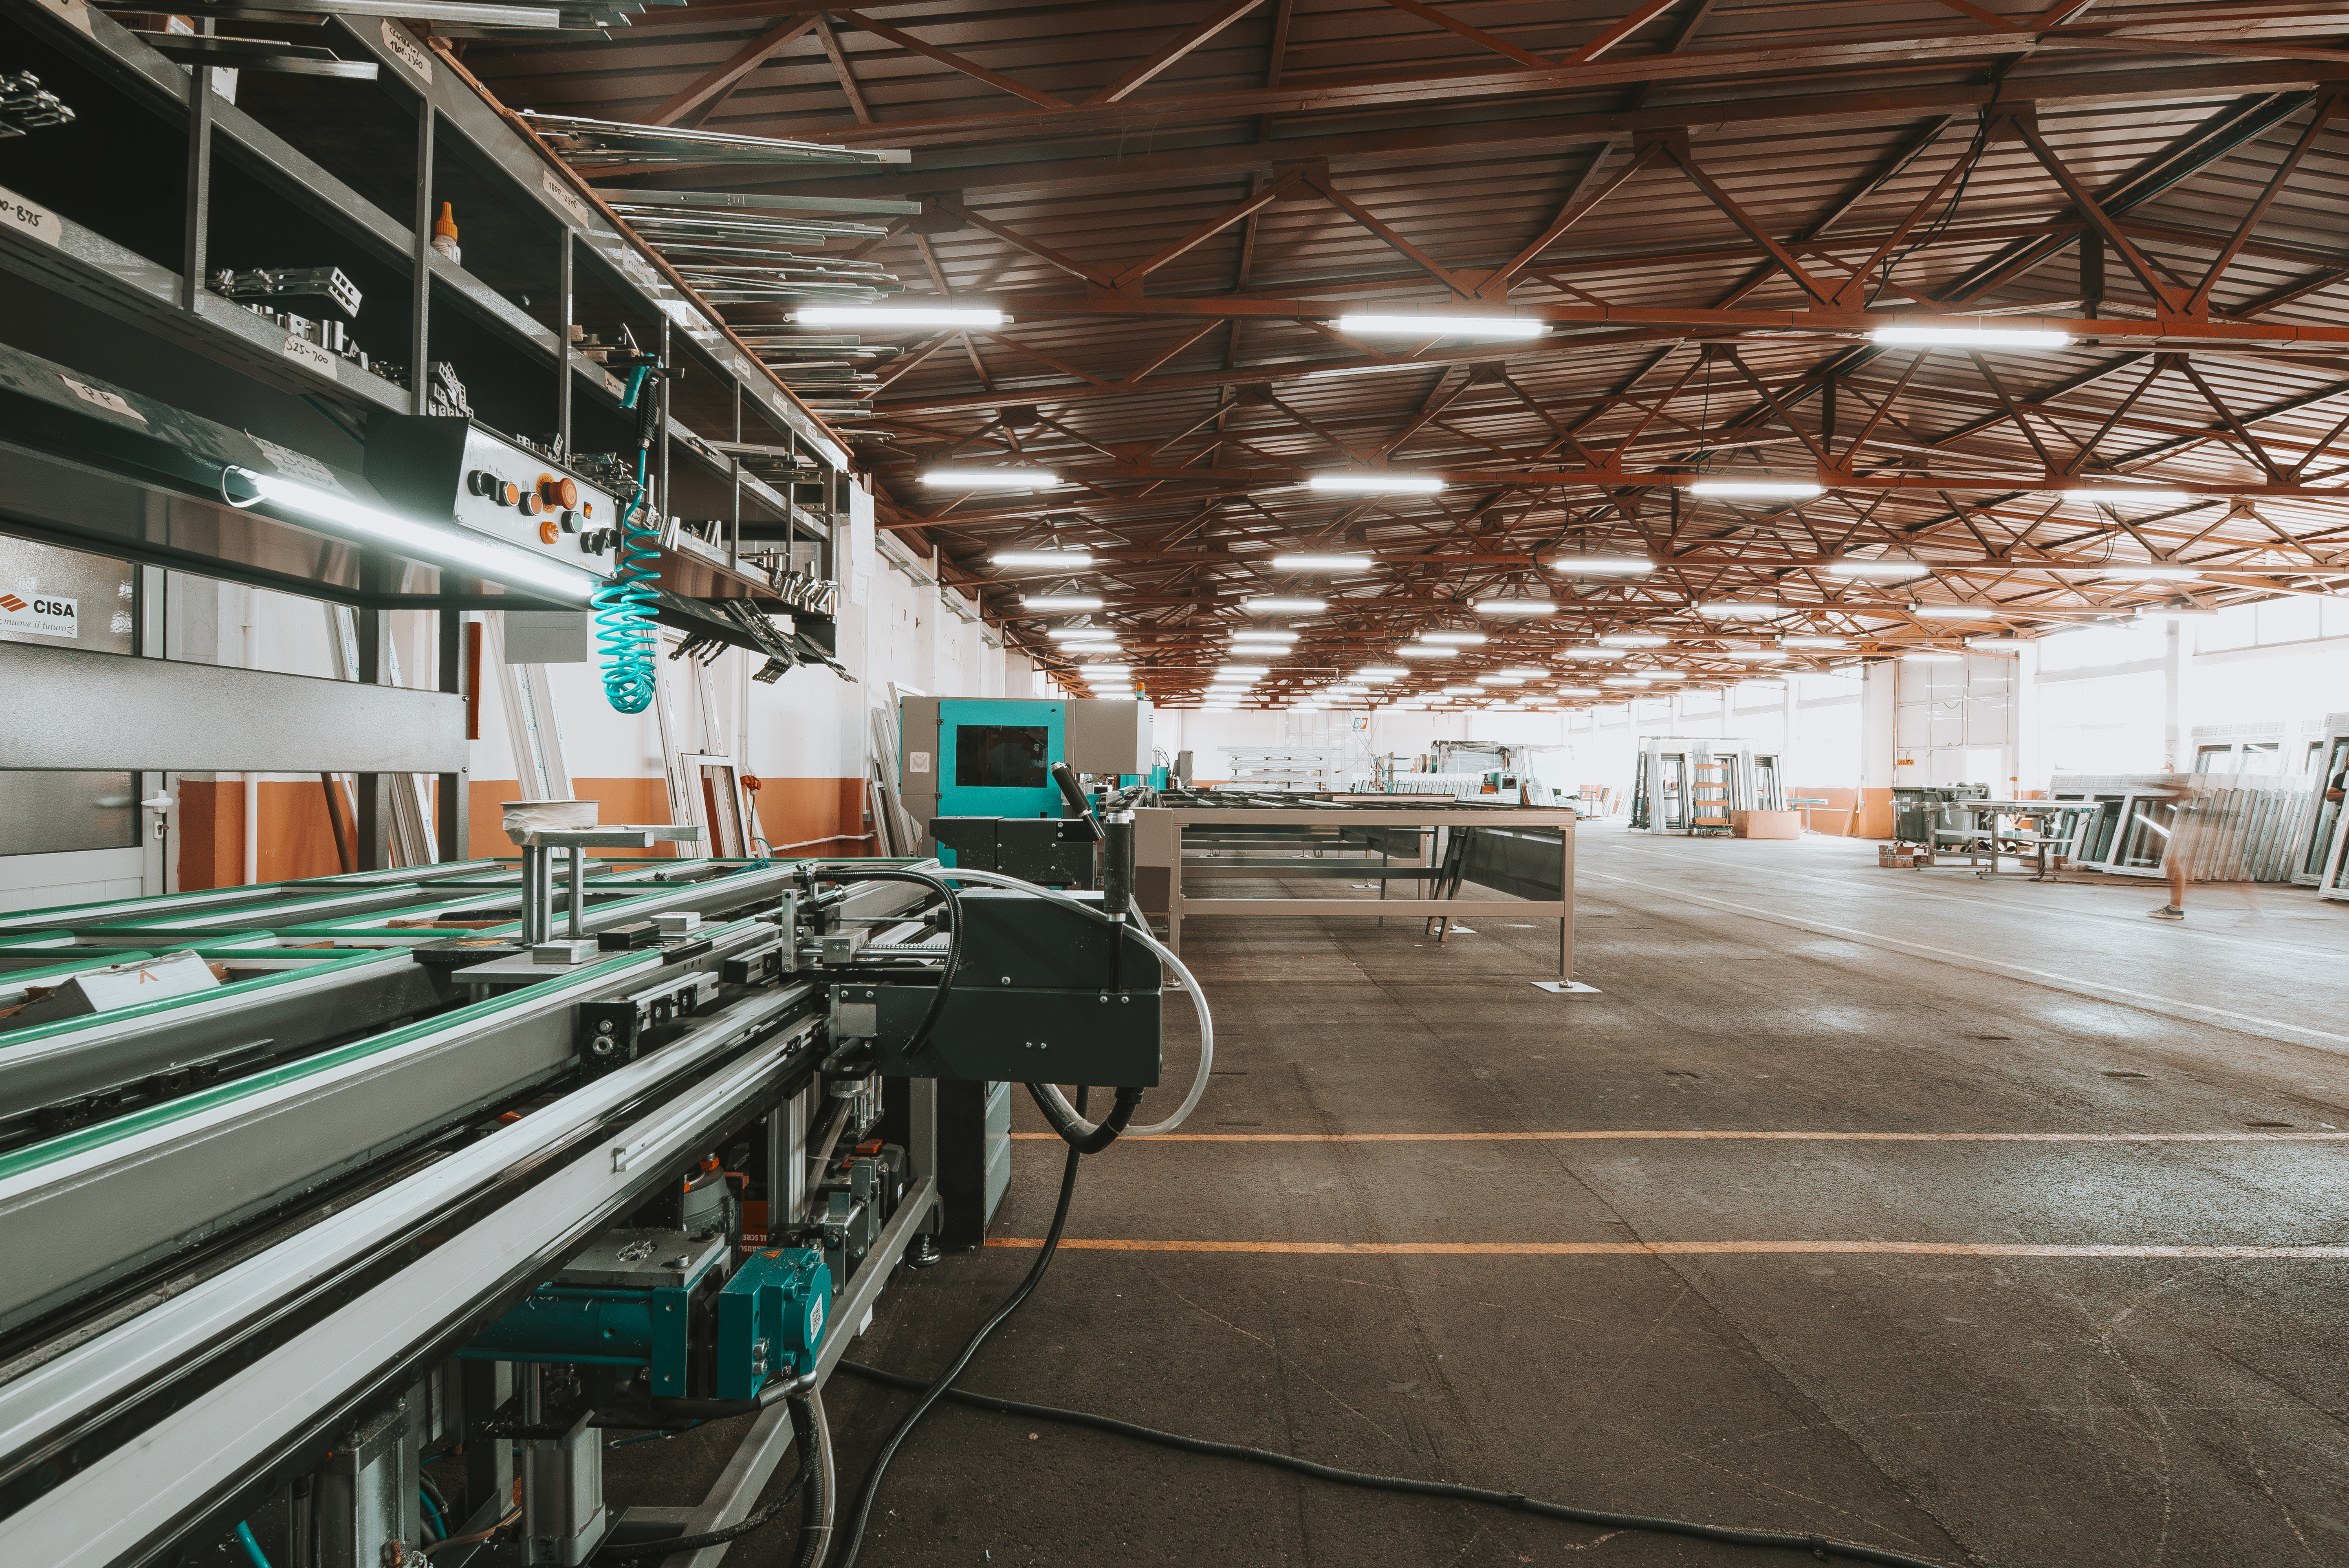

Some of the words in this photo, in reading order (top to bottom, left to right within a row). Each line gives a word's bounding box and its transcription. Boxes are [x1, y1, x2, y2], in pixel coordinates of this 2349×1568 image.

[390, 40, 423, 69] 1800-2300
[549, 181, 577, 208] 1800-2300
[0, 198, 42, 227] 0-875
[33, 599, 75, 618] CISA
[4, 619, 32, 628] muove
[34, 621, 40, 629] il
[41, 621, 67, 632] futuro
